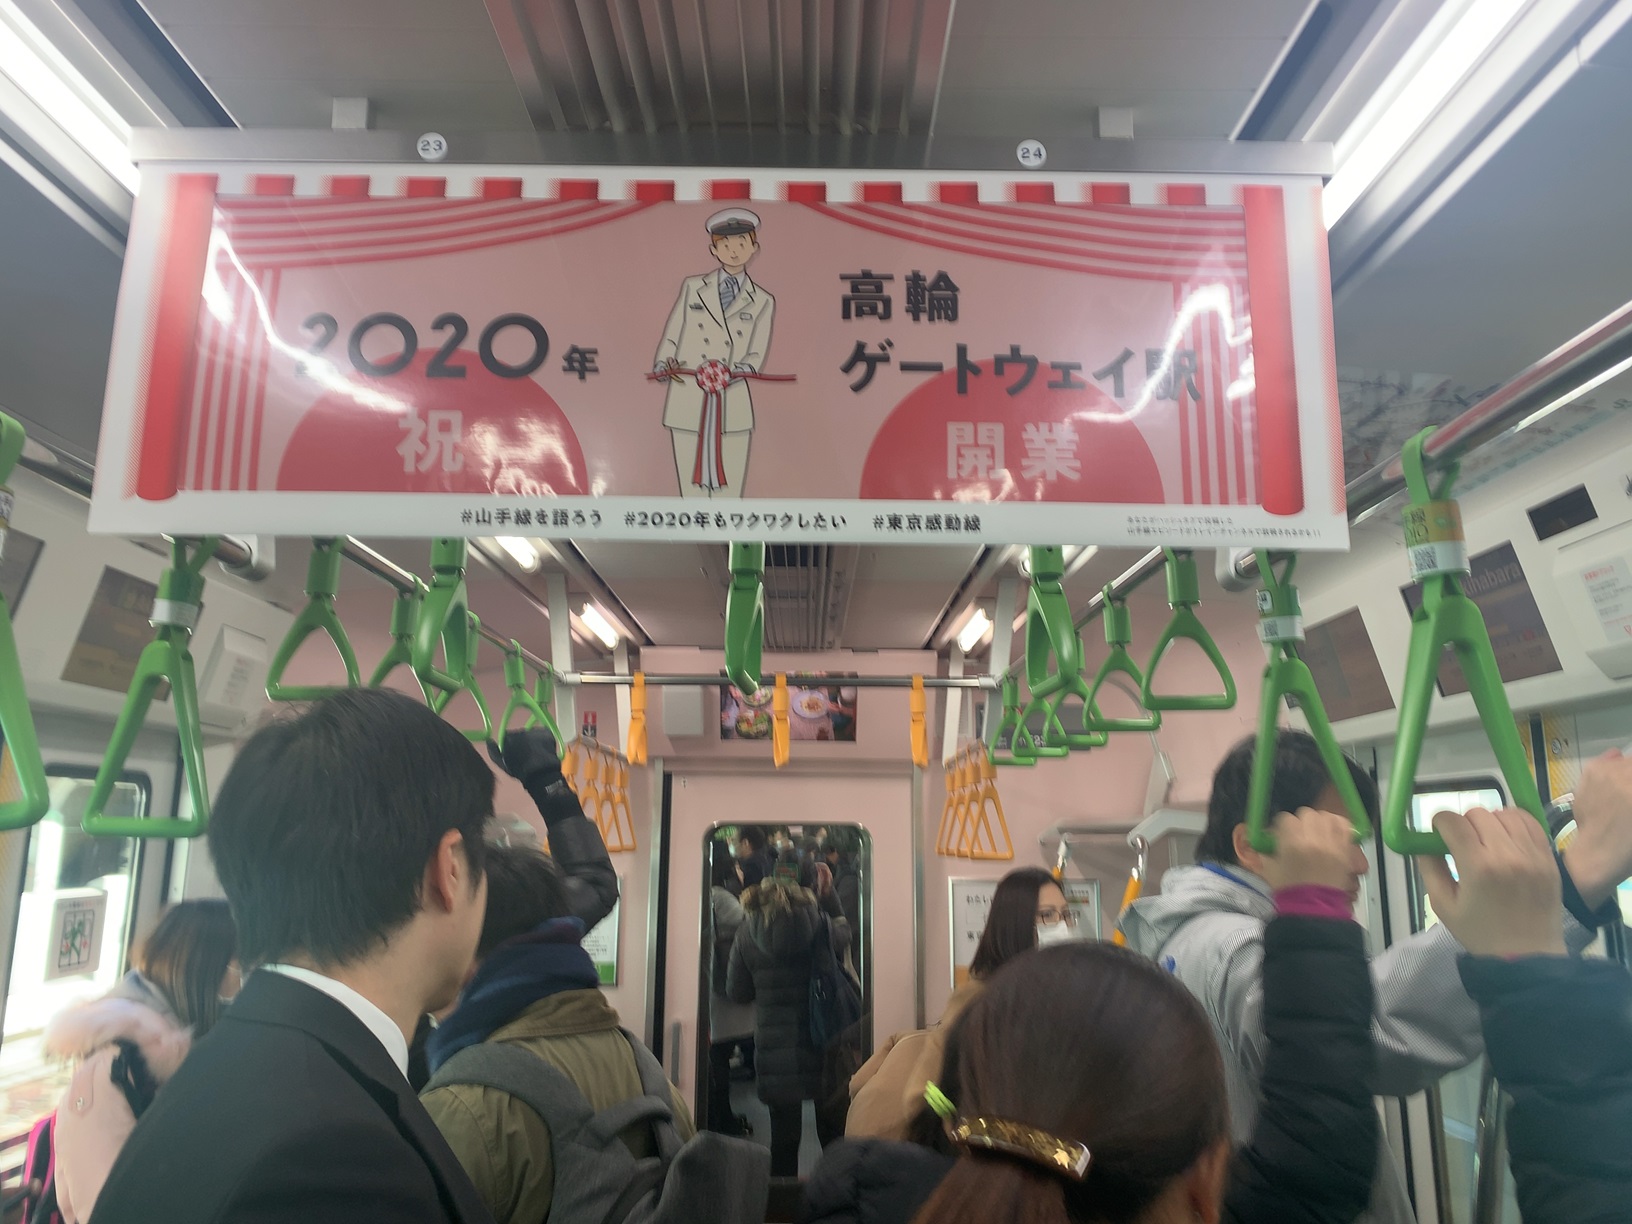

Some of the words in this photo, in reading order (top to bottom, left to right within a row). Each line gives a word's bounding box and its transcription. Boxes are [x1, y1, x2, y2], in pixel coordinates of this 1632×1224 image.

[420, 139, 443, 151] 23
[1021, 147, 1042, 159] 24
[839, 269, 960, 322] 高輪
[839, 338, 1202, 402] ゲートウェイ駅
[396, 408, 466, 474] 祝
[946, 420, 1082, 482] 開業
[460, 507, 602, 527] #山手線を語ろう
[623, 510, 847, 530] #2020年もワクワクしたい
[872, 513, 982, 532] #東京感動線
[1459, 561, 1523, 597] kihabara
